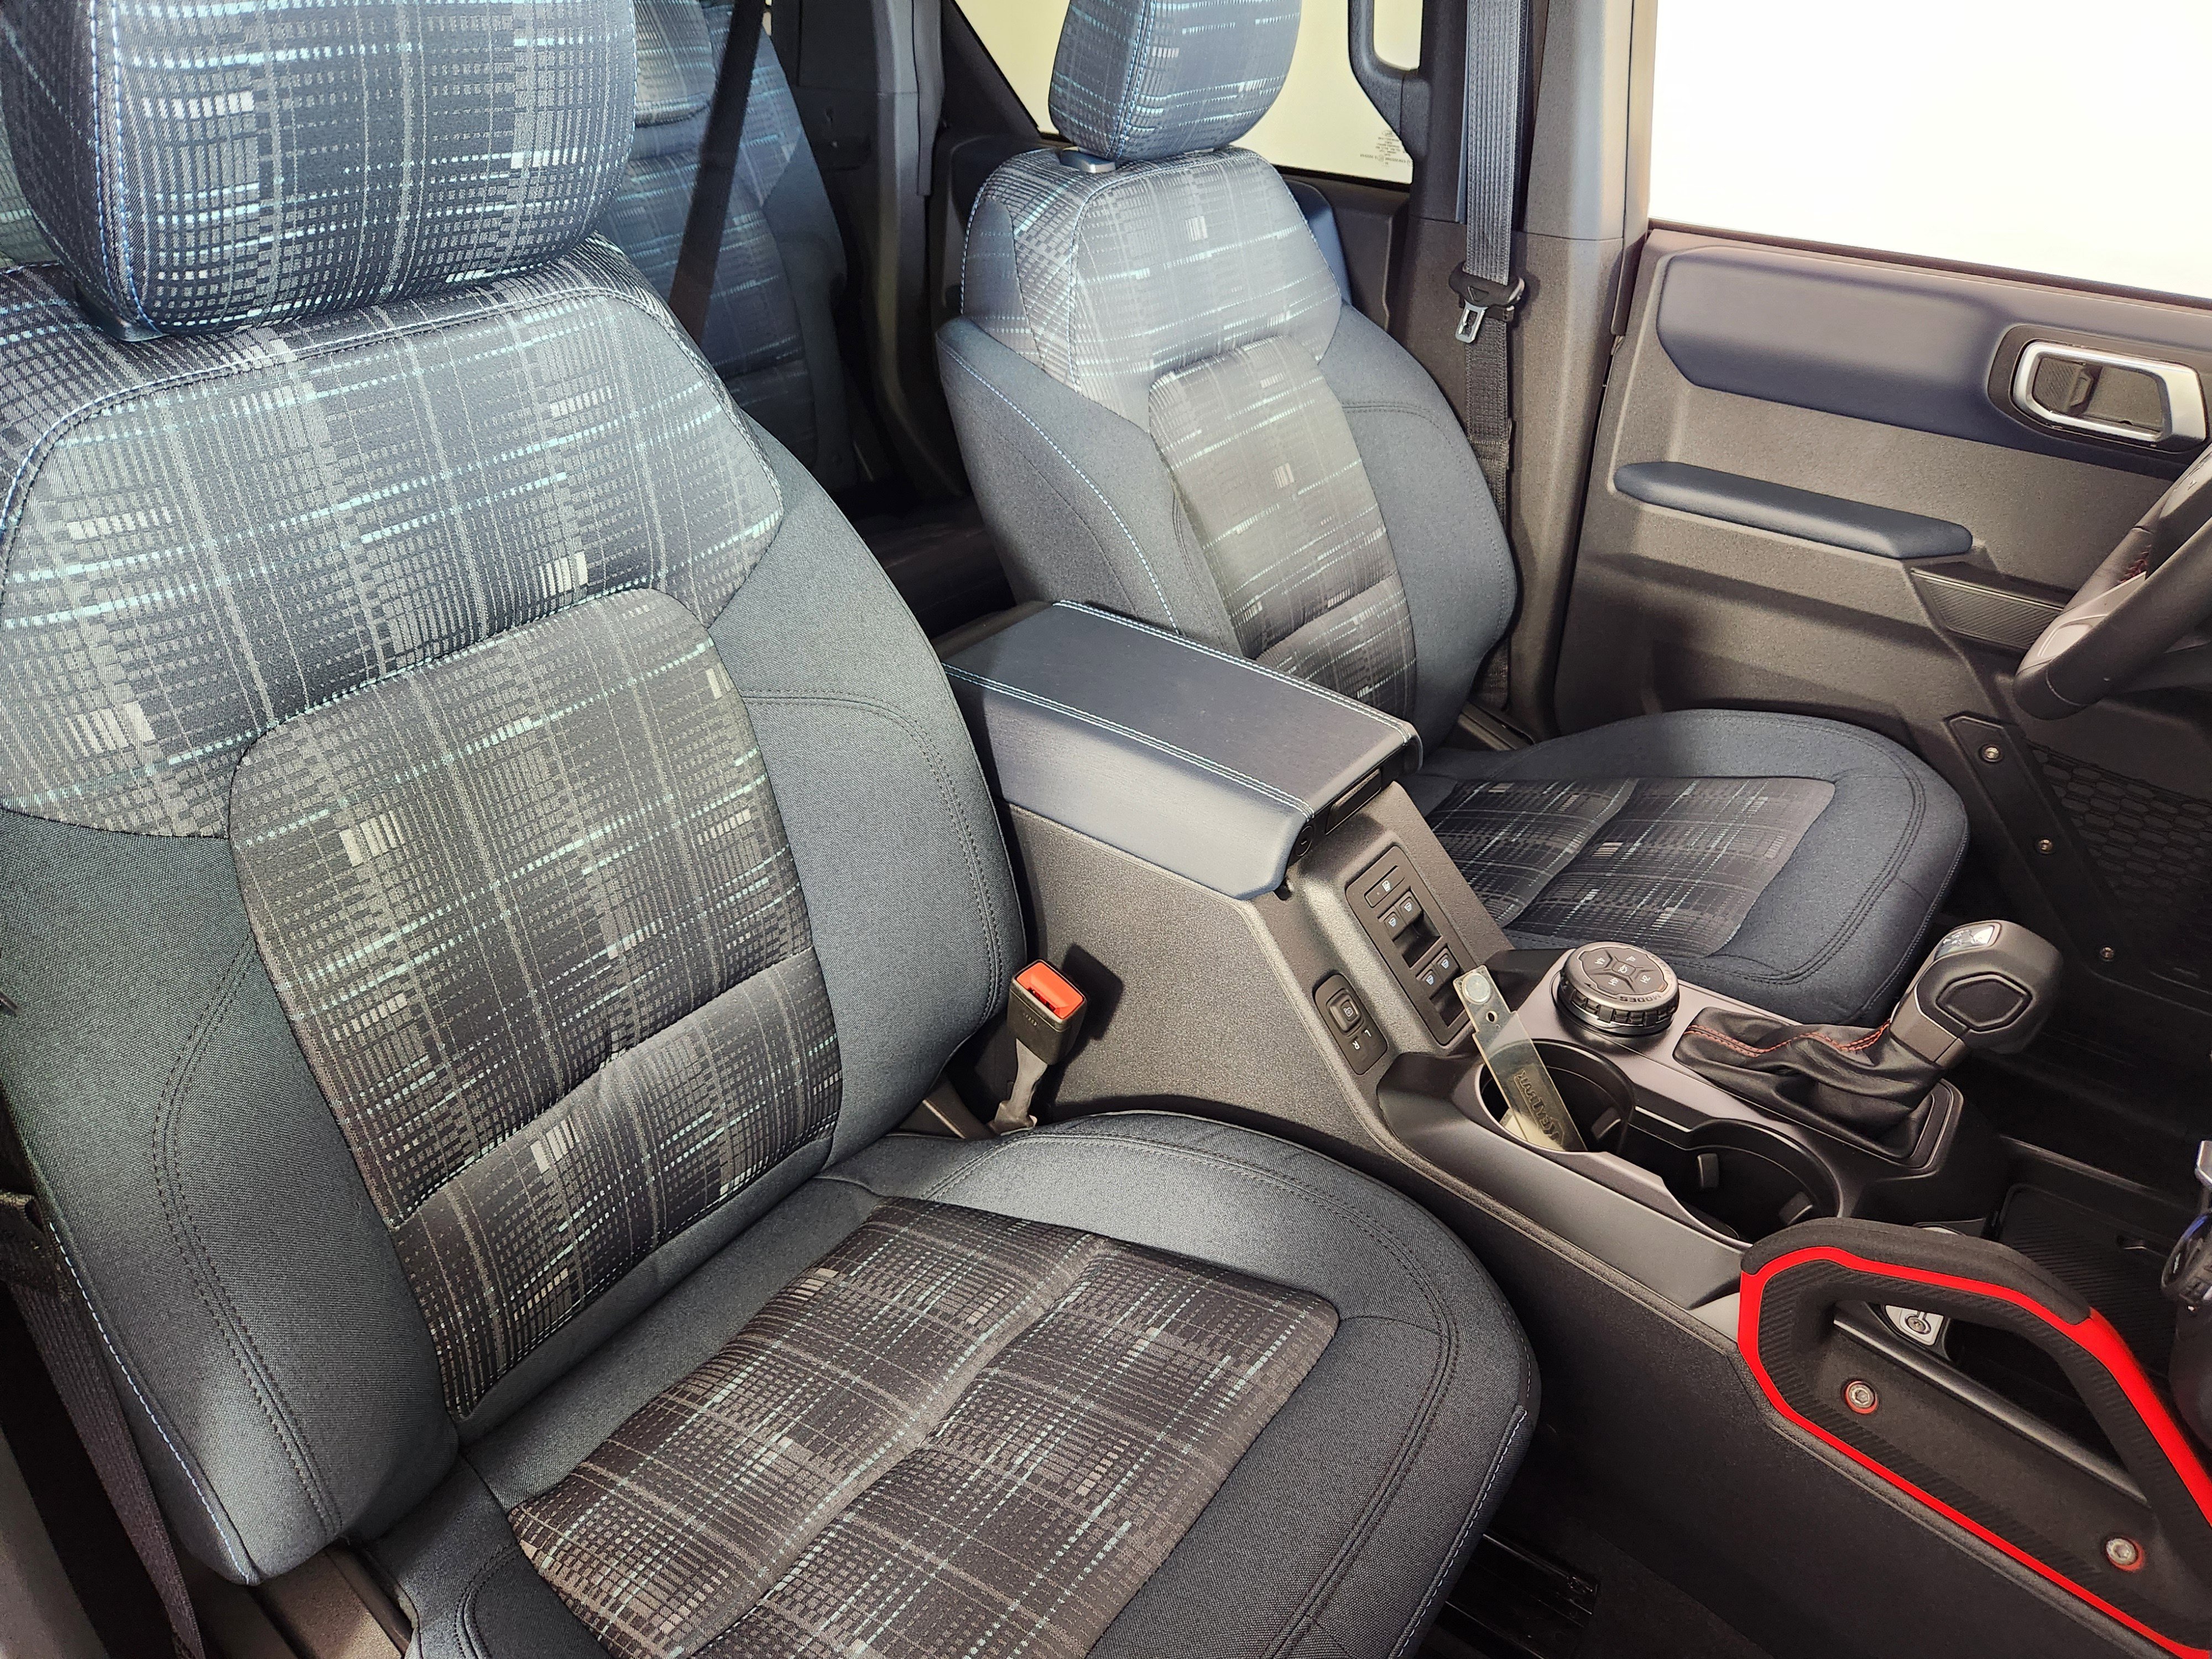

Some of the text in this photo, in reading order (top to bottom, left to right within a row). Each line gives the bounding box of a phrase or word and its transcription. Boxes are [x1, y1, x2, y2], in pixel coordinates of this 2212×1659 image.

[1594, 957, 1606, 966] 4A
[1608, 977, 1620, 987] 4H
[1640, 974, 1651, 984] 2H
[1619, 994, 1663, 1003] MODES
[1353, 1040, 1360, 1050] R
